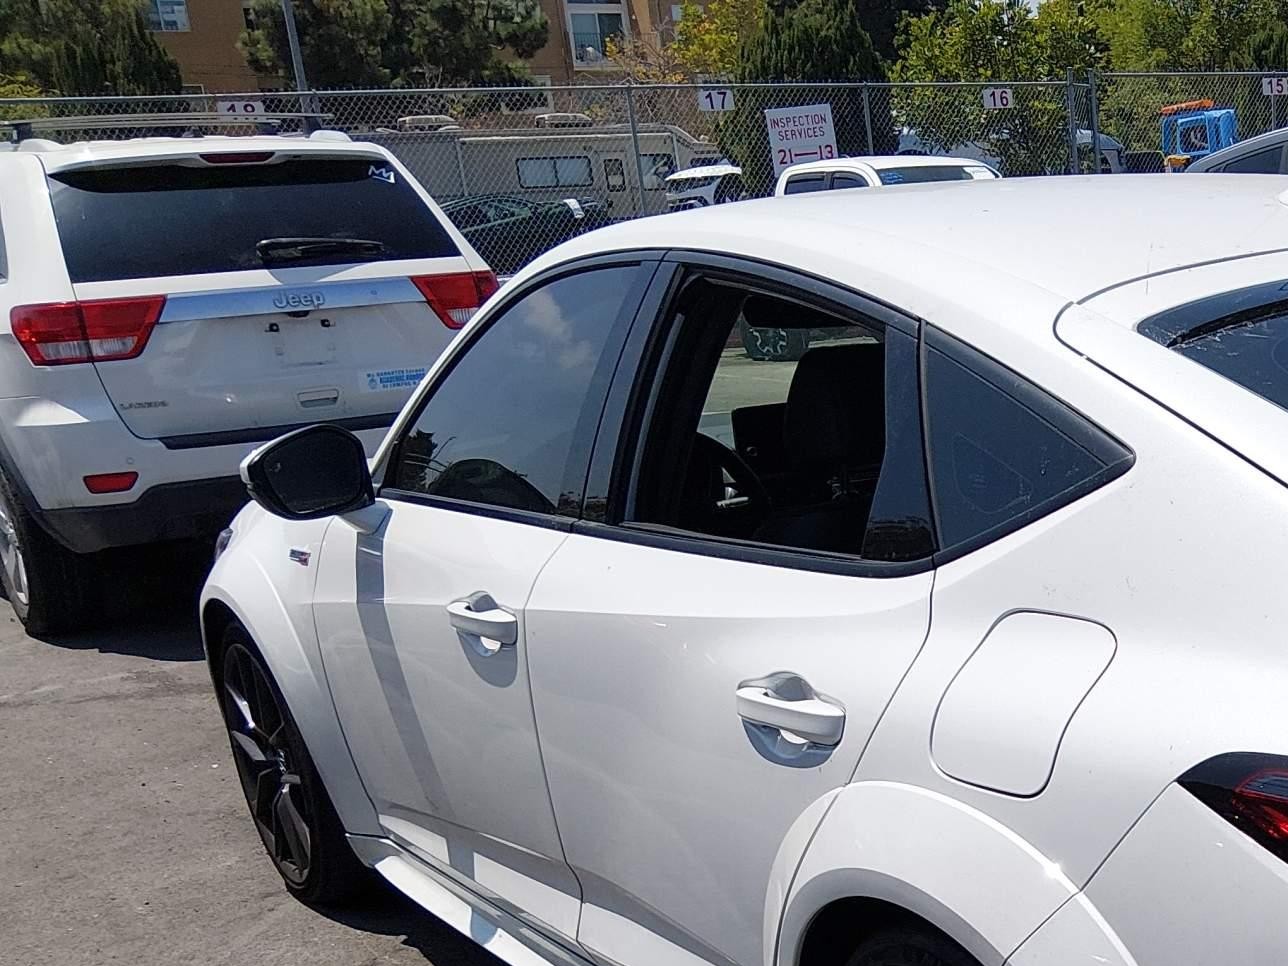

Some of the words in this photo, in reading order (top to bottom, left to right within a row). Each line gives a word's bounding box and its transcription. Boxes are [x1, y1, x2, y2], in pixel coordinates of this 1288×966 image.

[1266, 78, 1284, 94] 15
[704, 91, 728, 110] 17
[989, 90, 1009, 107] 16
[769, 113, 828, 129] INSPECTION
[777, 127, 825, 142] SERVICES
[272, 290, 326, 310] Jeep
